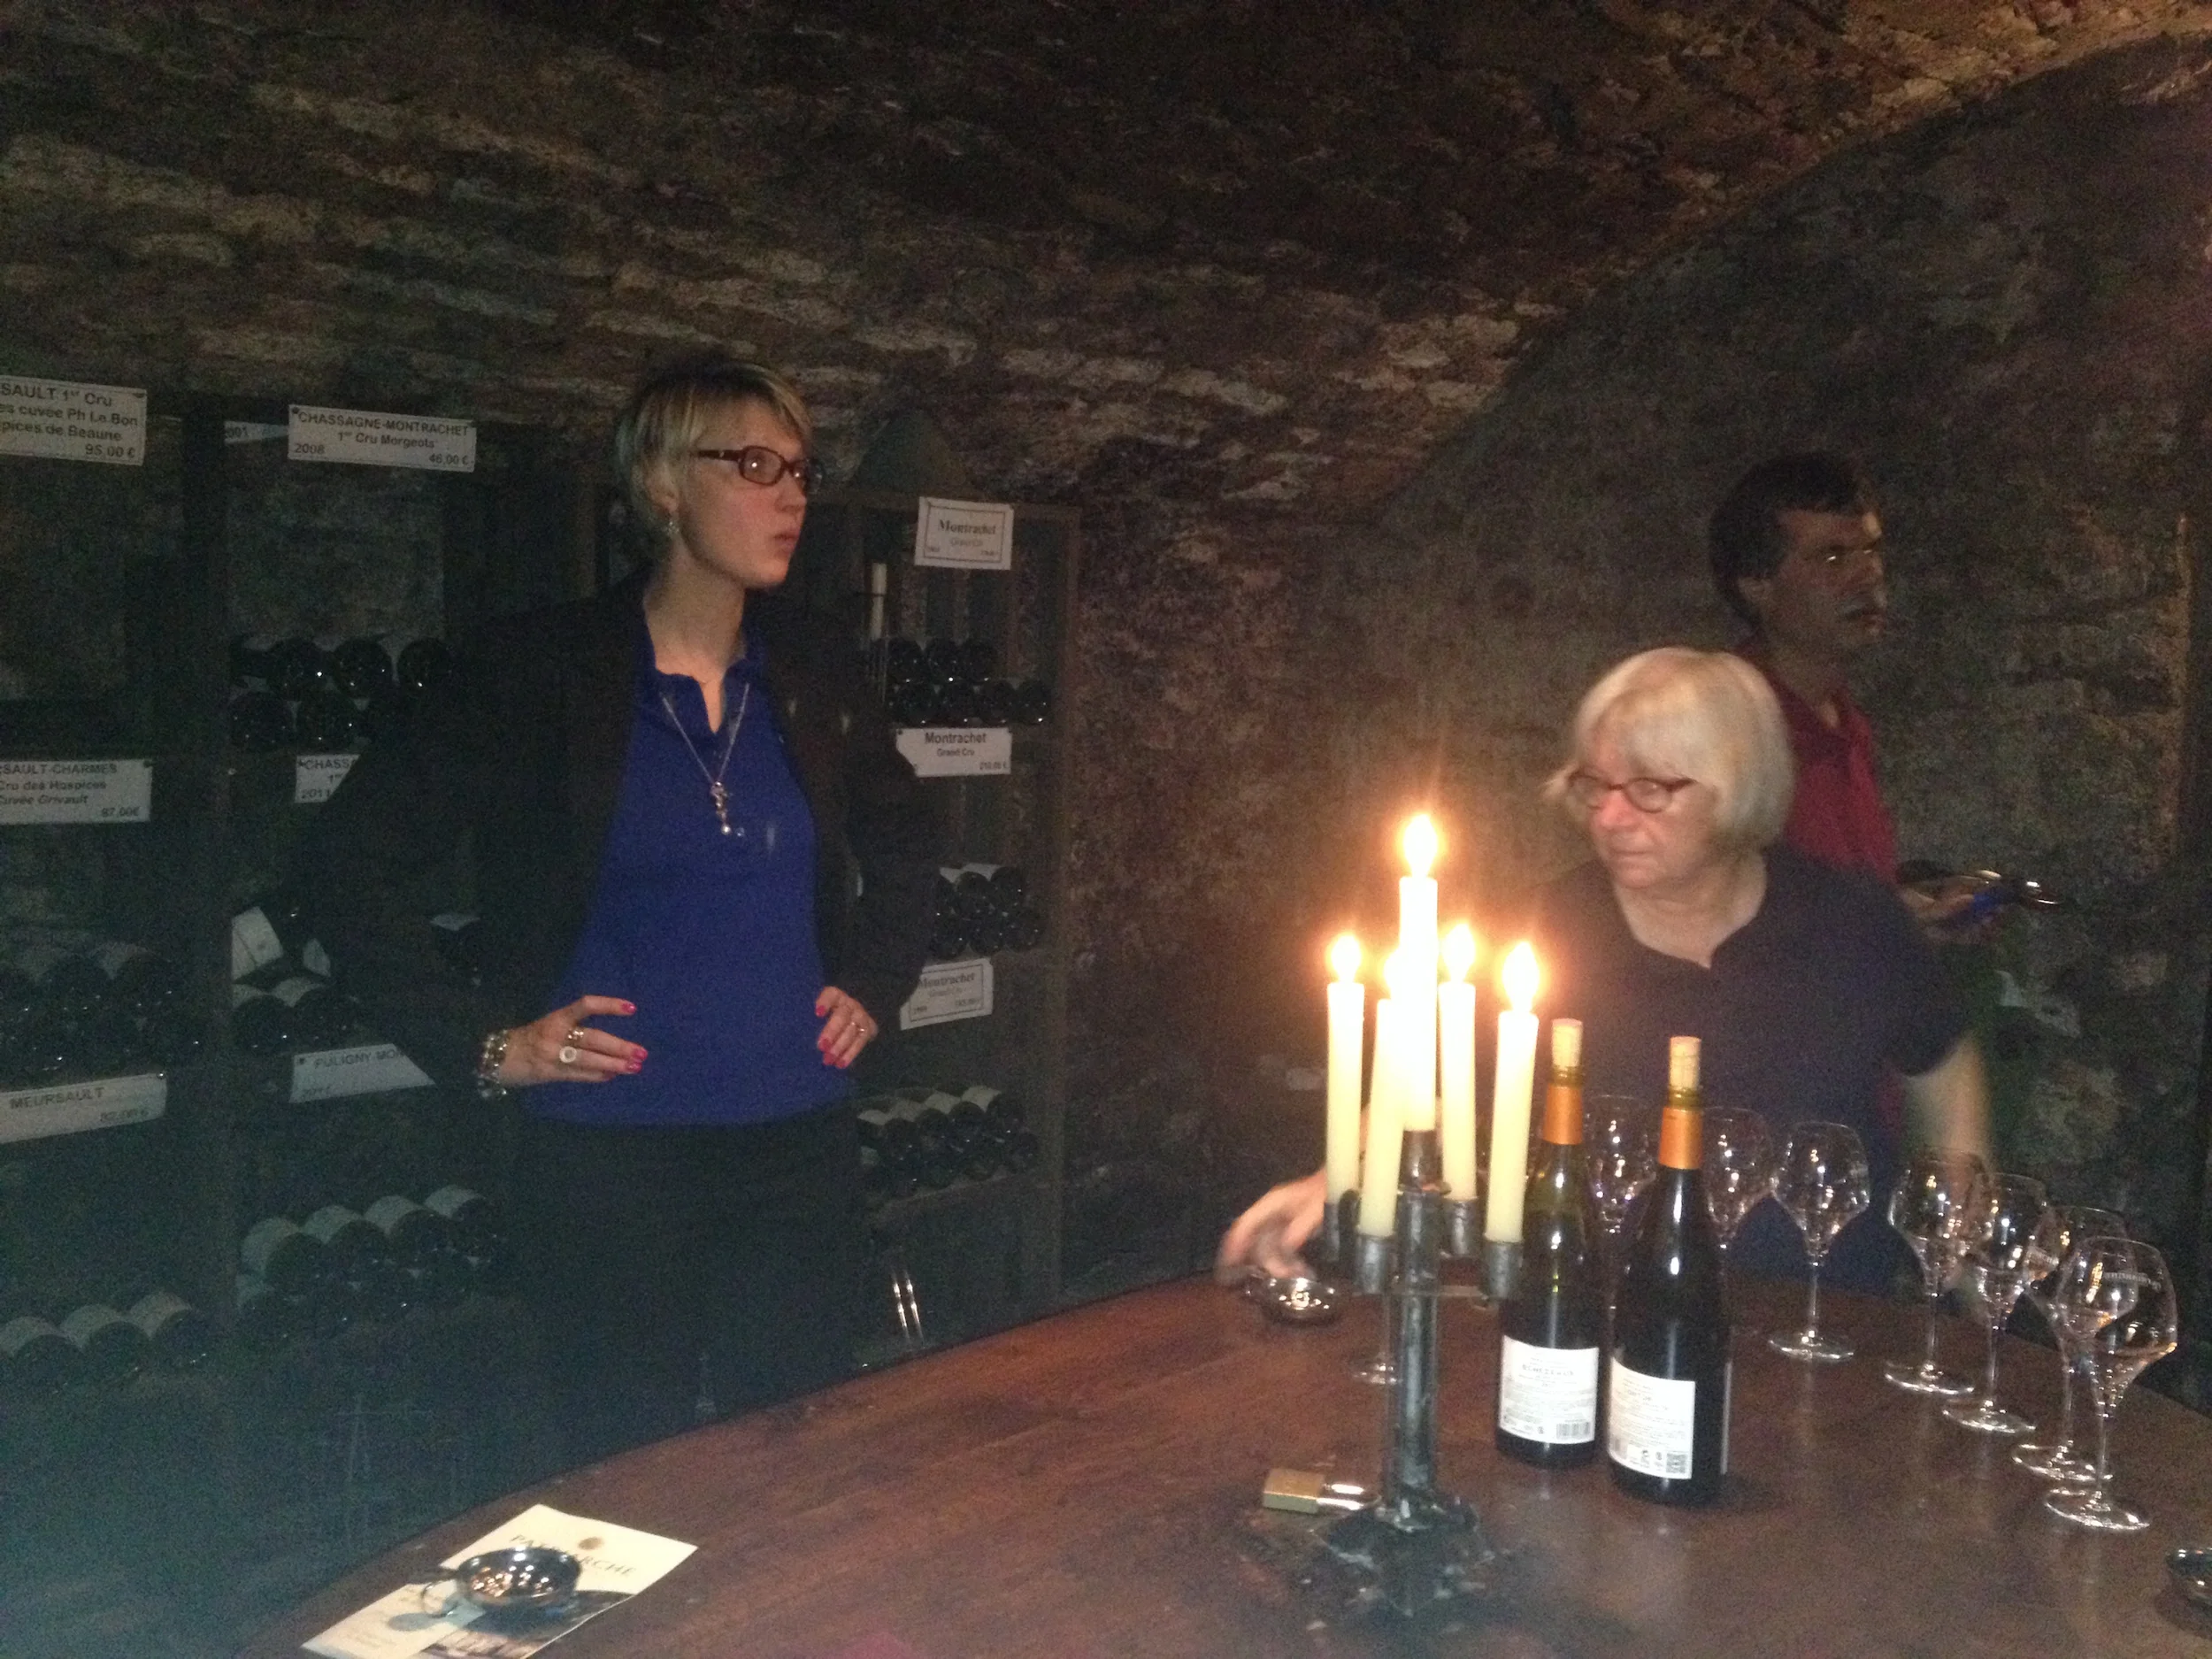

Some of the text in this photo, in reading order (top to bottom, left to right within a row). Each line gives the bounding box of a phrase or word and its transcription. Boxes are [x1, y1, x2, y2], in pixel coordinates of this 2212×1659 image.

[85, 392, 112, 407] Cru
[67, 407, 86, 421] Ph
[90, 411, 107, 424] Le
[111, 413, 138, 426] Bon
[298, 411, 469, 437] CHASSAGNE-MONTRACHET
[45, 423, 64, 437] de
[68, 425, 122, 442] Beaune
[356, 432, 378, 445] Cru
[924, 732, 987, 744] Montrachet
[0, 763, 118, 775] SAULT-CHARMES
[9, 1087, 105, 1109] MEURSAULT
